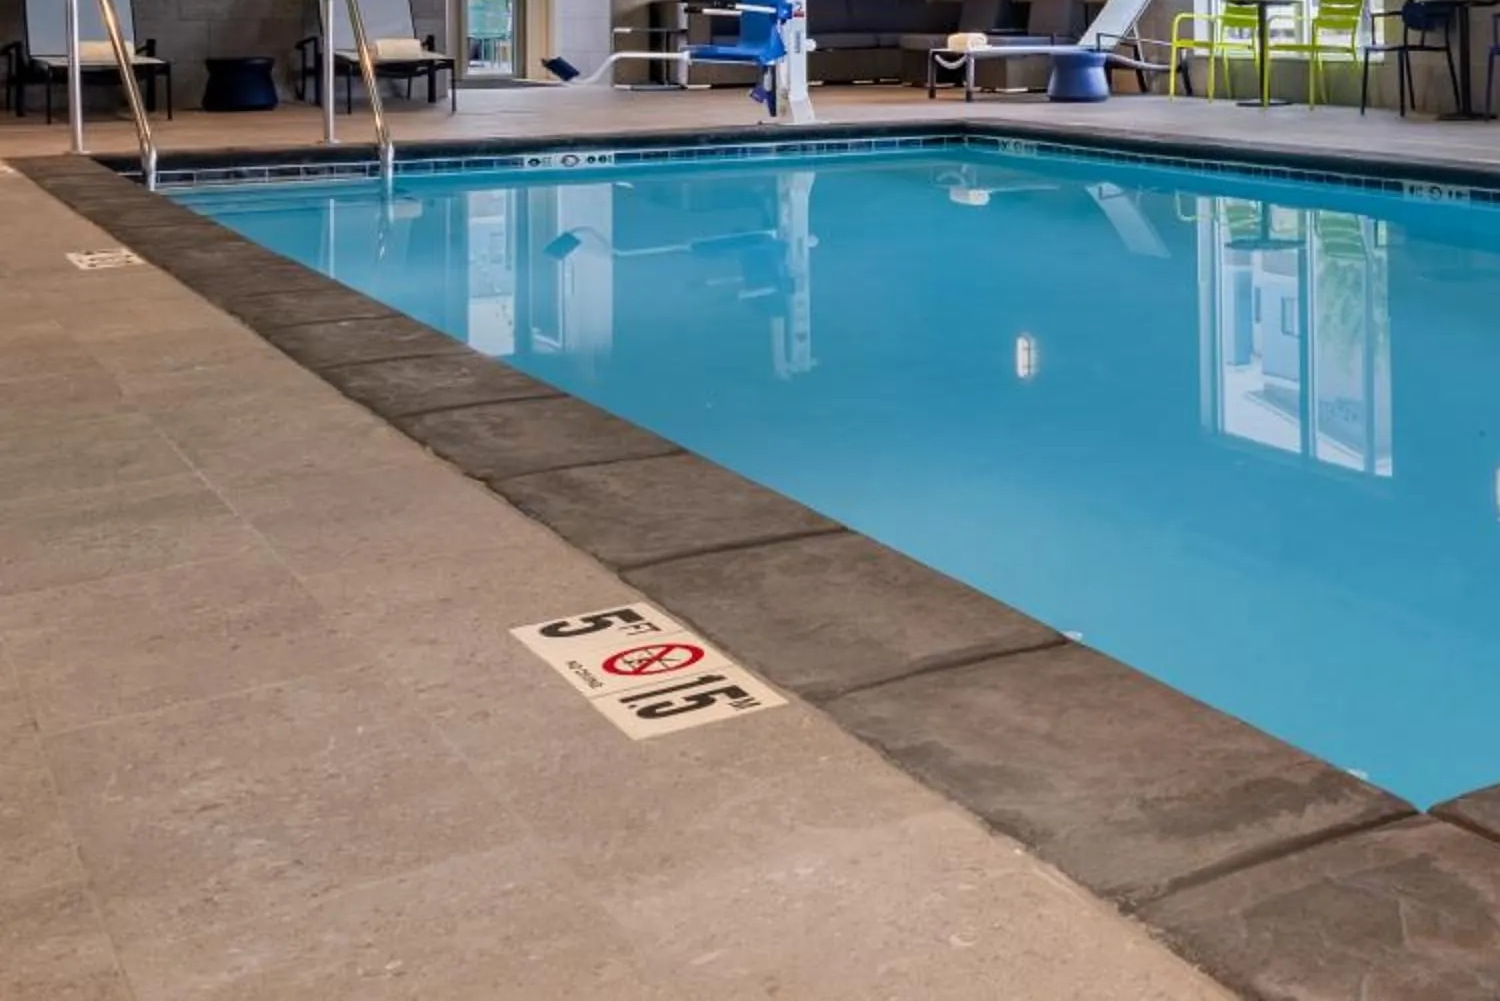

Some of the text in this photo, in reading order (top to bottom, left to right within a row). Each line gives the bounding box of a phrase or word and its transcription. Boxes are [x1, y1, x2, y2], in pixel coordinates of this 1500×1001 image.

[538, 608, 662, 638] 5 FT
[619, 674, 761, 719] 1.5 M
